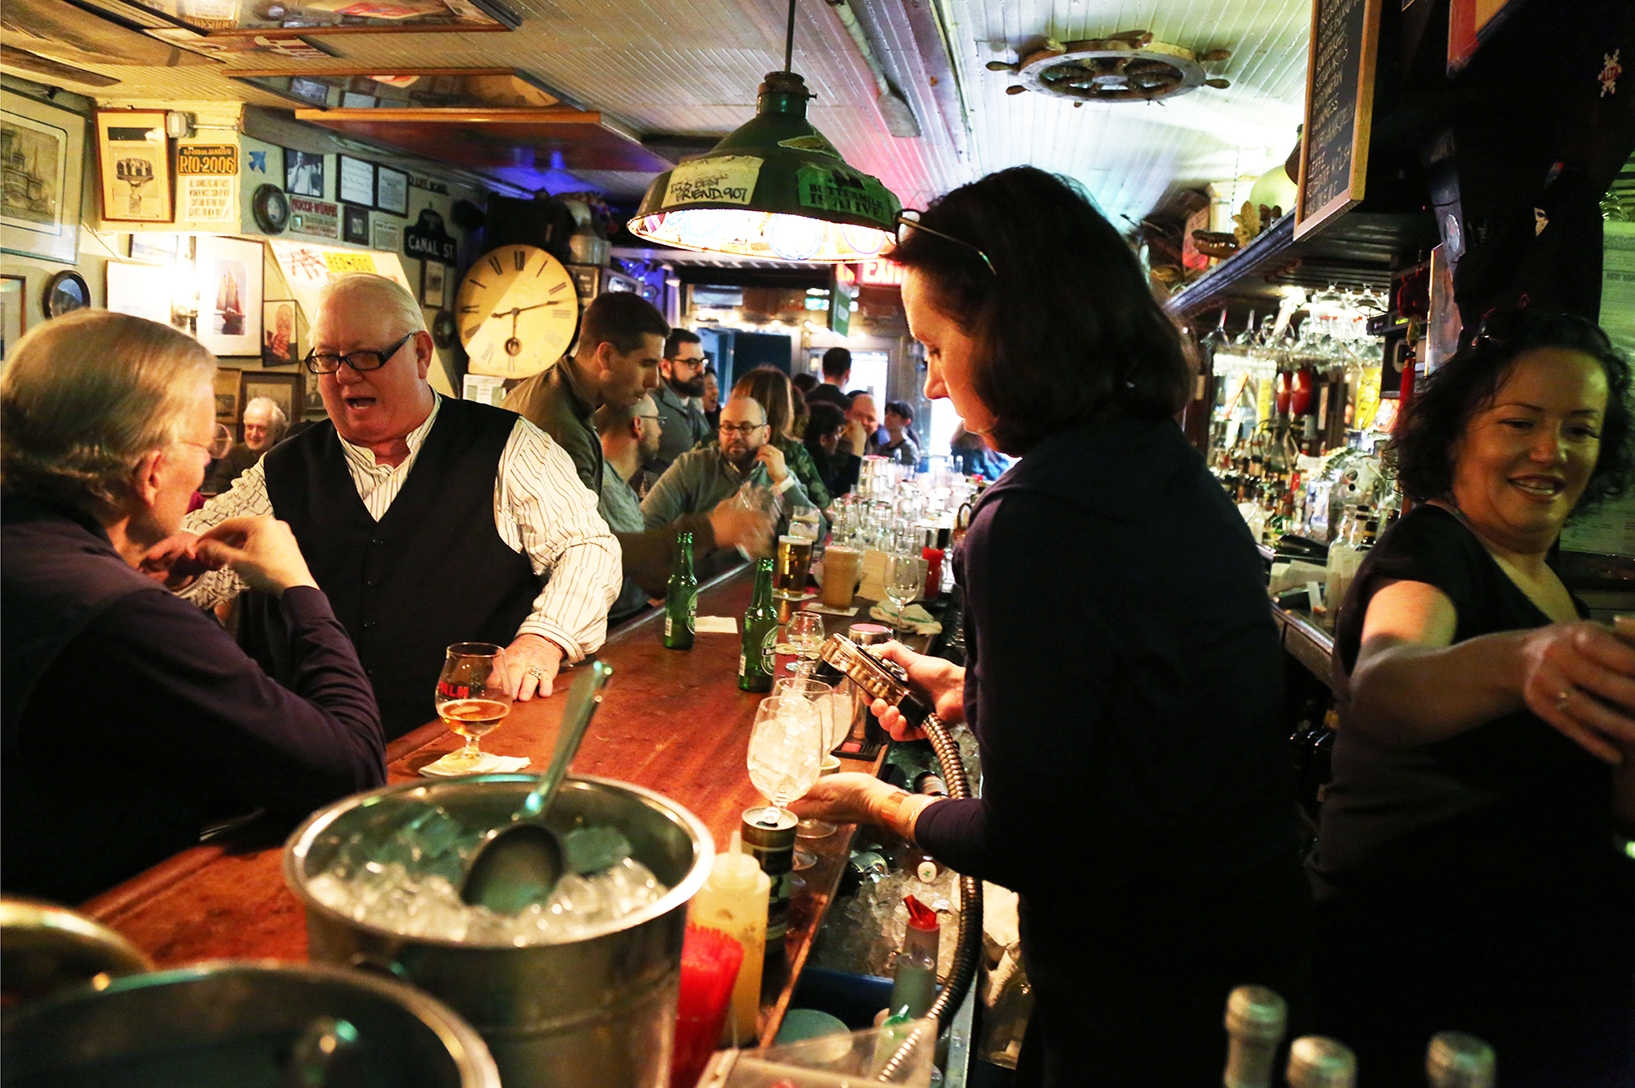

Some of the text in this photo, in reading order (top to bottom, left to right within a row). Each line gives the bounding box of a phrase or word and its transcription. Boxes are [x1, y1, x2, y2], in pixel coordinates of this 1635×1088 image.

[809, 183, 883, 209] BUTTERMILK
[810, 193, 823, 204] IS
[408, 234, 440, 255] CANAL
